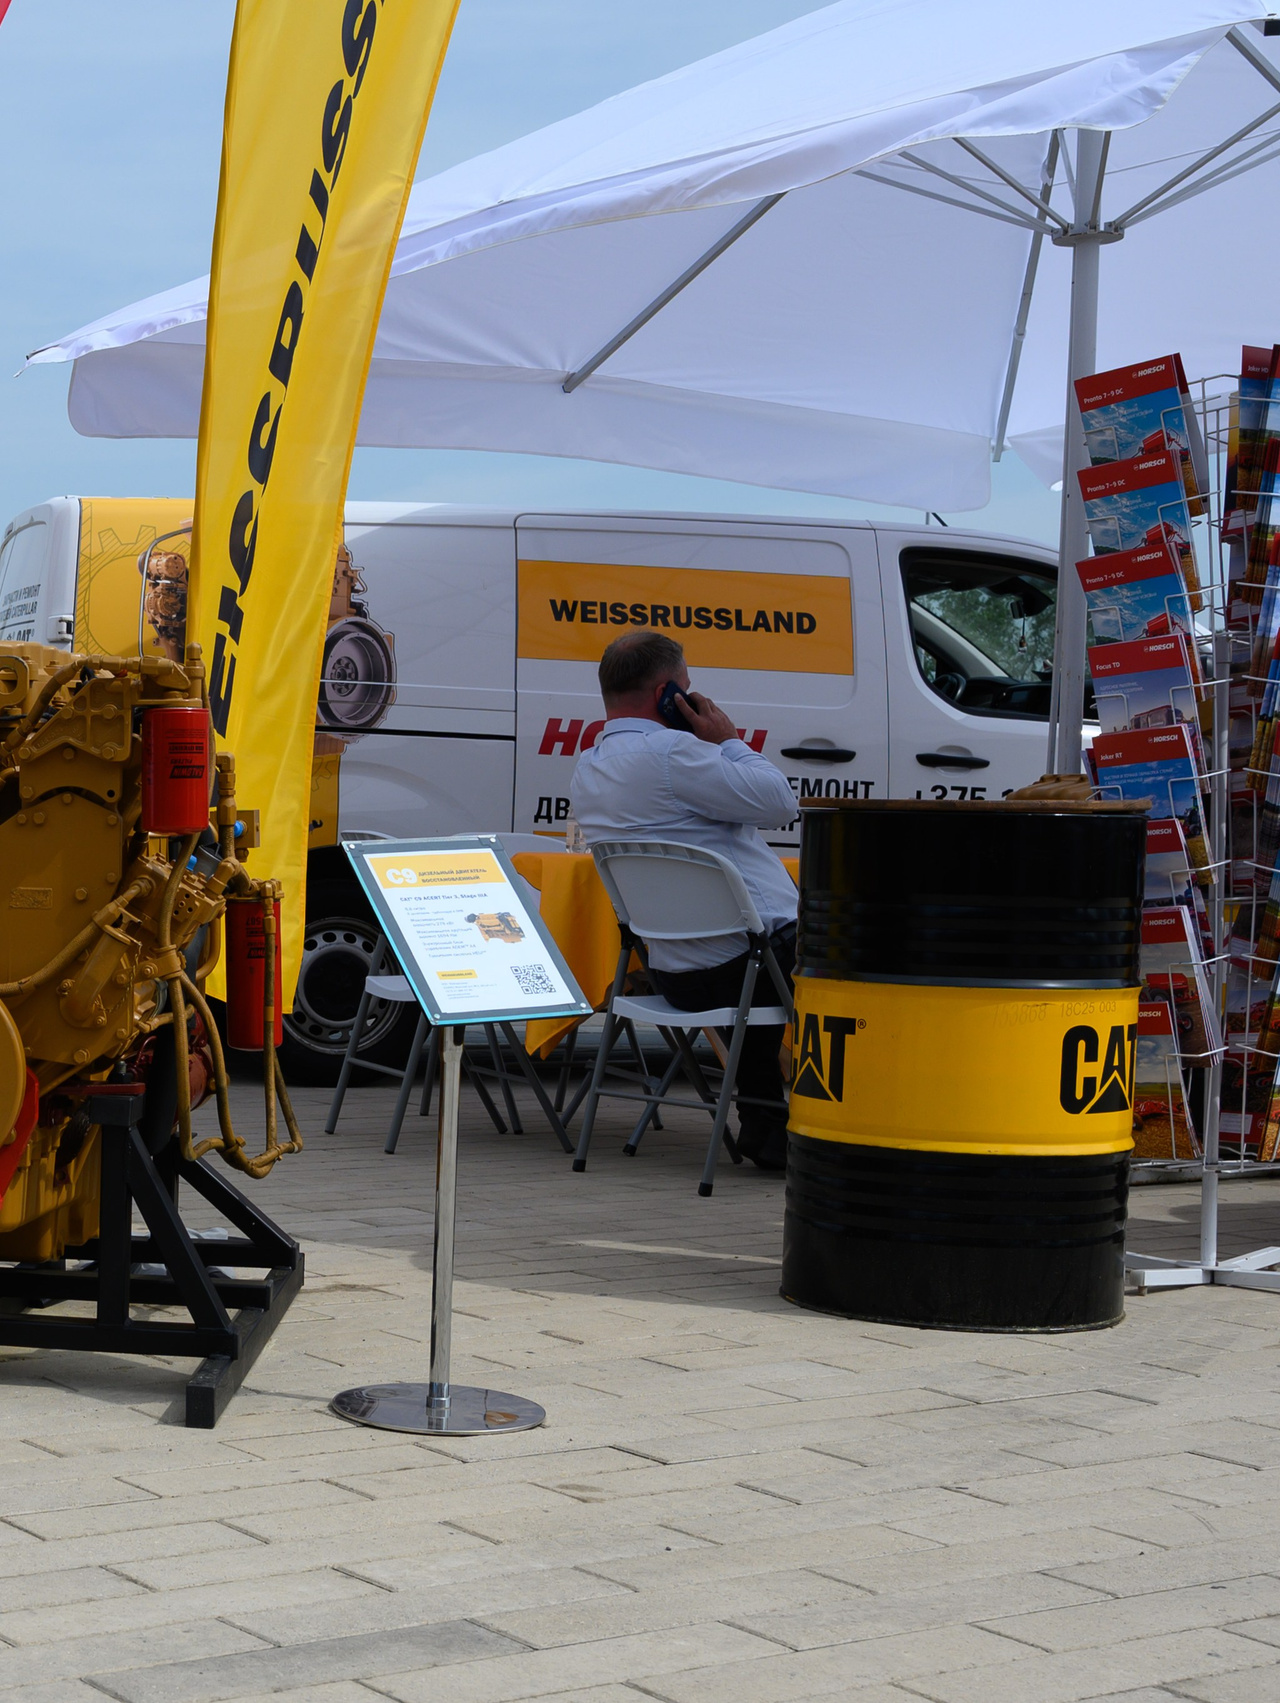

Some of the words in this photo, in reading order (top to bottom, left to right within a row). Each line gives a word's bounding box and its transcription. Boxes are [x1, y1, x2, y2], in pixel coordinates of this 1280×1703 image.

[1138, 364, 1166, 378] HORSCH
[1084, 394, 1102, 404] Pronto
[1139, 458, 1166, 471] HORSCH
[1087, 483, 1106, 493] Pronto
[1137, 551, 1162, 563] HORSCH
[1086, 575, 1105, 585] Pronto
[549, 599, 817, 635] WEISSRUSSLAND
[1149, 642, 1174, 652] HORSCH
[1096, 663, 1111, 671] Focus
[1153, 733, 1178, 743] HORSCH
[1100, 753, 1115, 761] Joker
[1147, 828, 1172, 836] HORSCH
[386, 868, 417, 883] C9
[422, 875, 480, 883] ВОССТАНОВЛЕННЫЙ
[1149, 918, 1175, 926] HORSCH
[1099, 1001, 1117, 1013] 003
[1138, 1010, 1161, 1018] ORSCH
[1060, 1023, 1138, 1115] CAT
